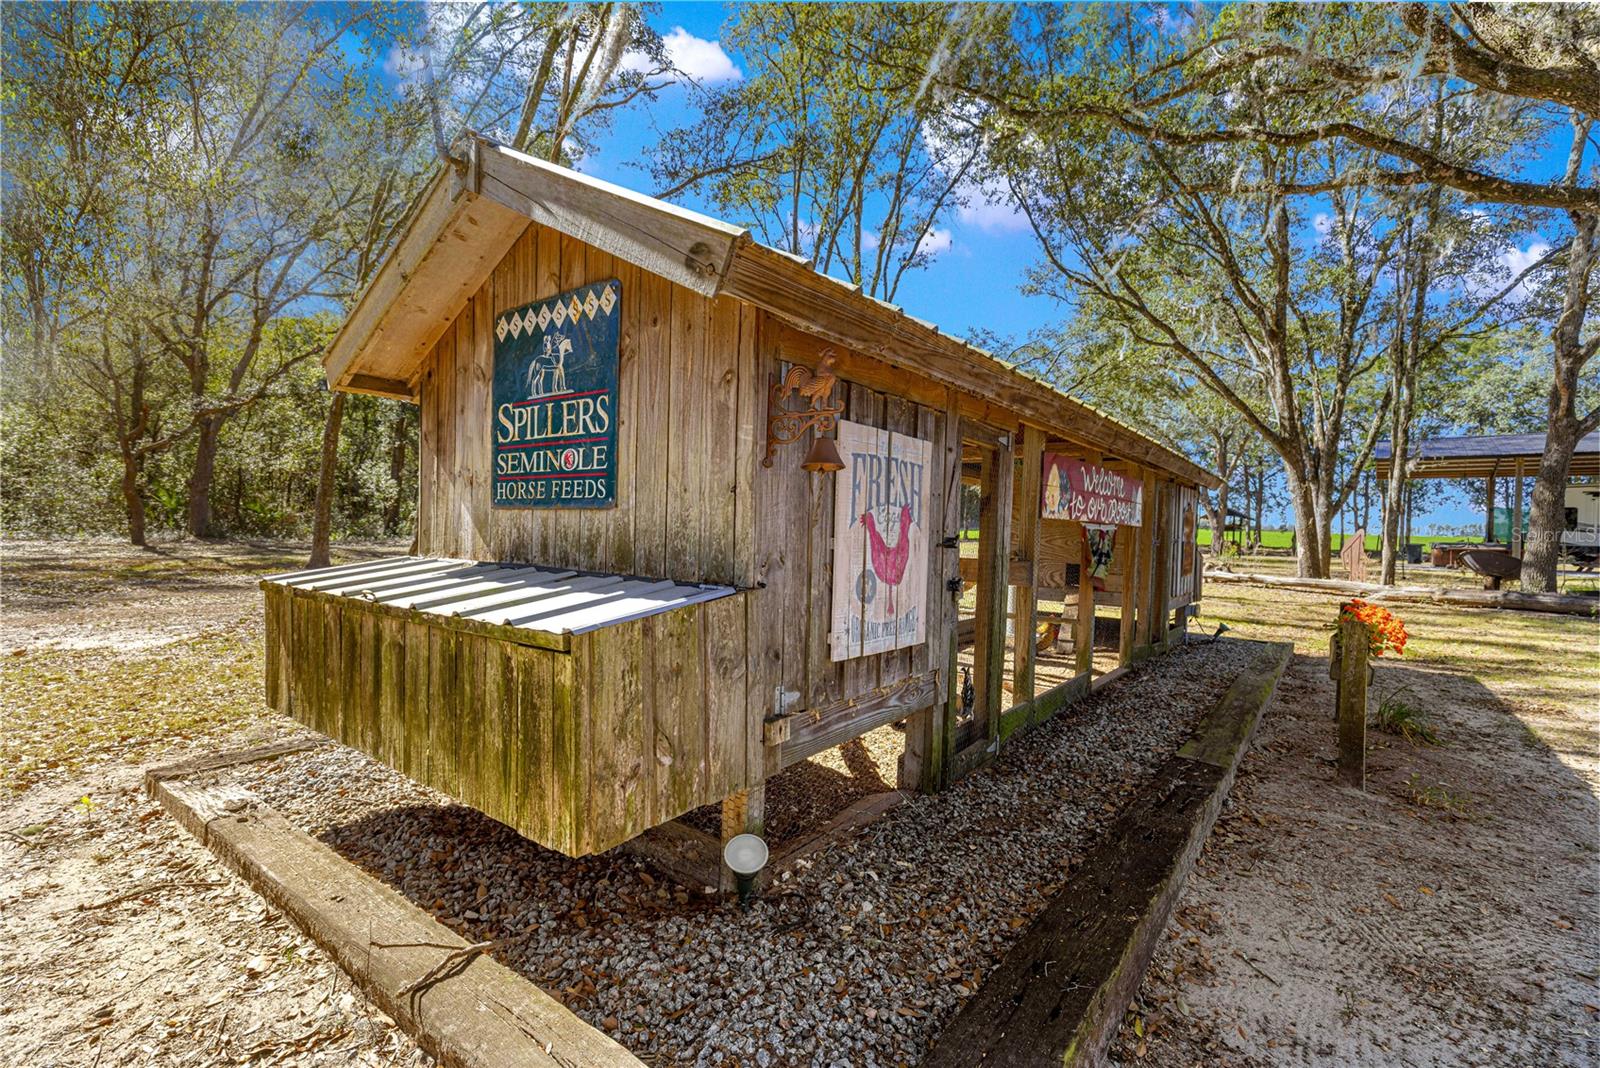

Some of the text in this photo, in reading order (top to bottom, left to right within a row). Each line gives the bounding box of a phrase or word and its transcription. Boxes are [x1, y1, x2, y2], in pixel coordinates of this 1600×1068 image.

[497, 395, 609, 444] SPILLERS
[497, 445, 608, 475] SEMINOLE
[496, 478, 606, 500] HORSE FEEDS
[849, 453, 923, 530] FRESH
[1081, 466, 1125, 498] Welcome
[1069, 491, 1086, 520] to
[1087, 497, 1107, 522] our
